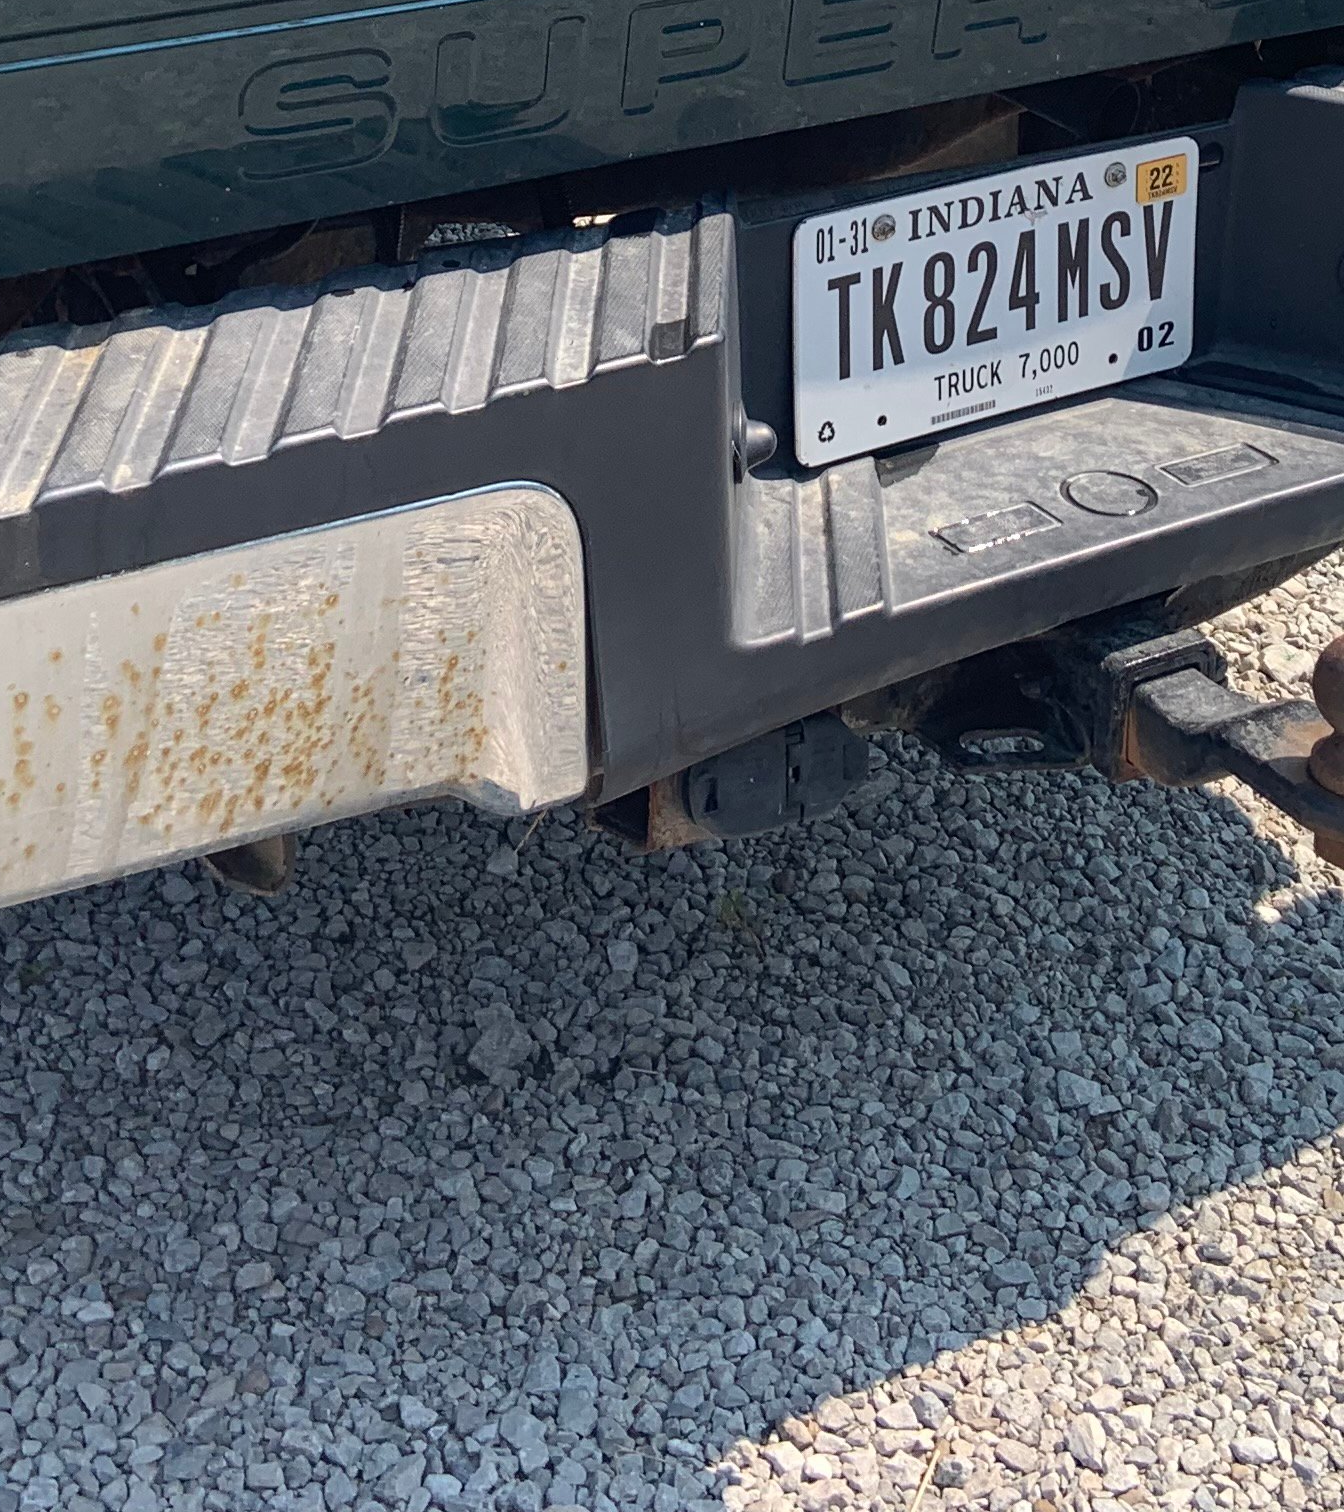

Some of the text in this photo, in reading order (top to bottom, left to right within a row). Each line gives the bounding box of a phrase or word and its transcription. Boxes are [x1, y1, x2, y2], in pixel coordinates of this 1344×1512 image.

[1149, 163, 1173, 190] 22
[908, 172, 1094, 242] INDIANA
[816, 217, 868, 265] 01-31
[1137, 321, 1175, 352] 02
[934, 341, 1080, 401] TRUCK 7,000
